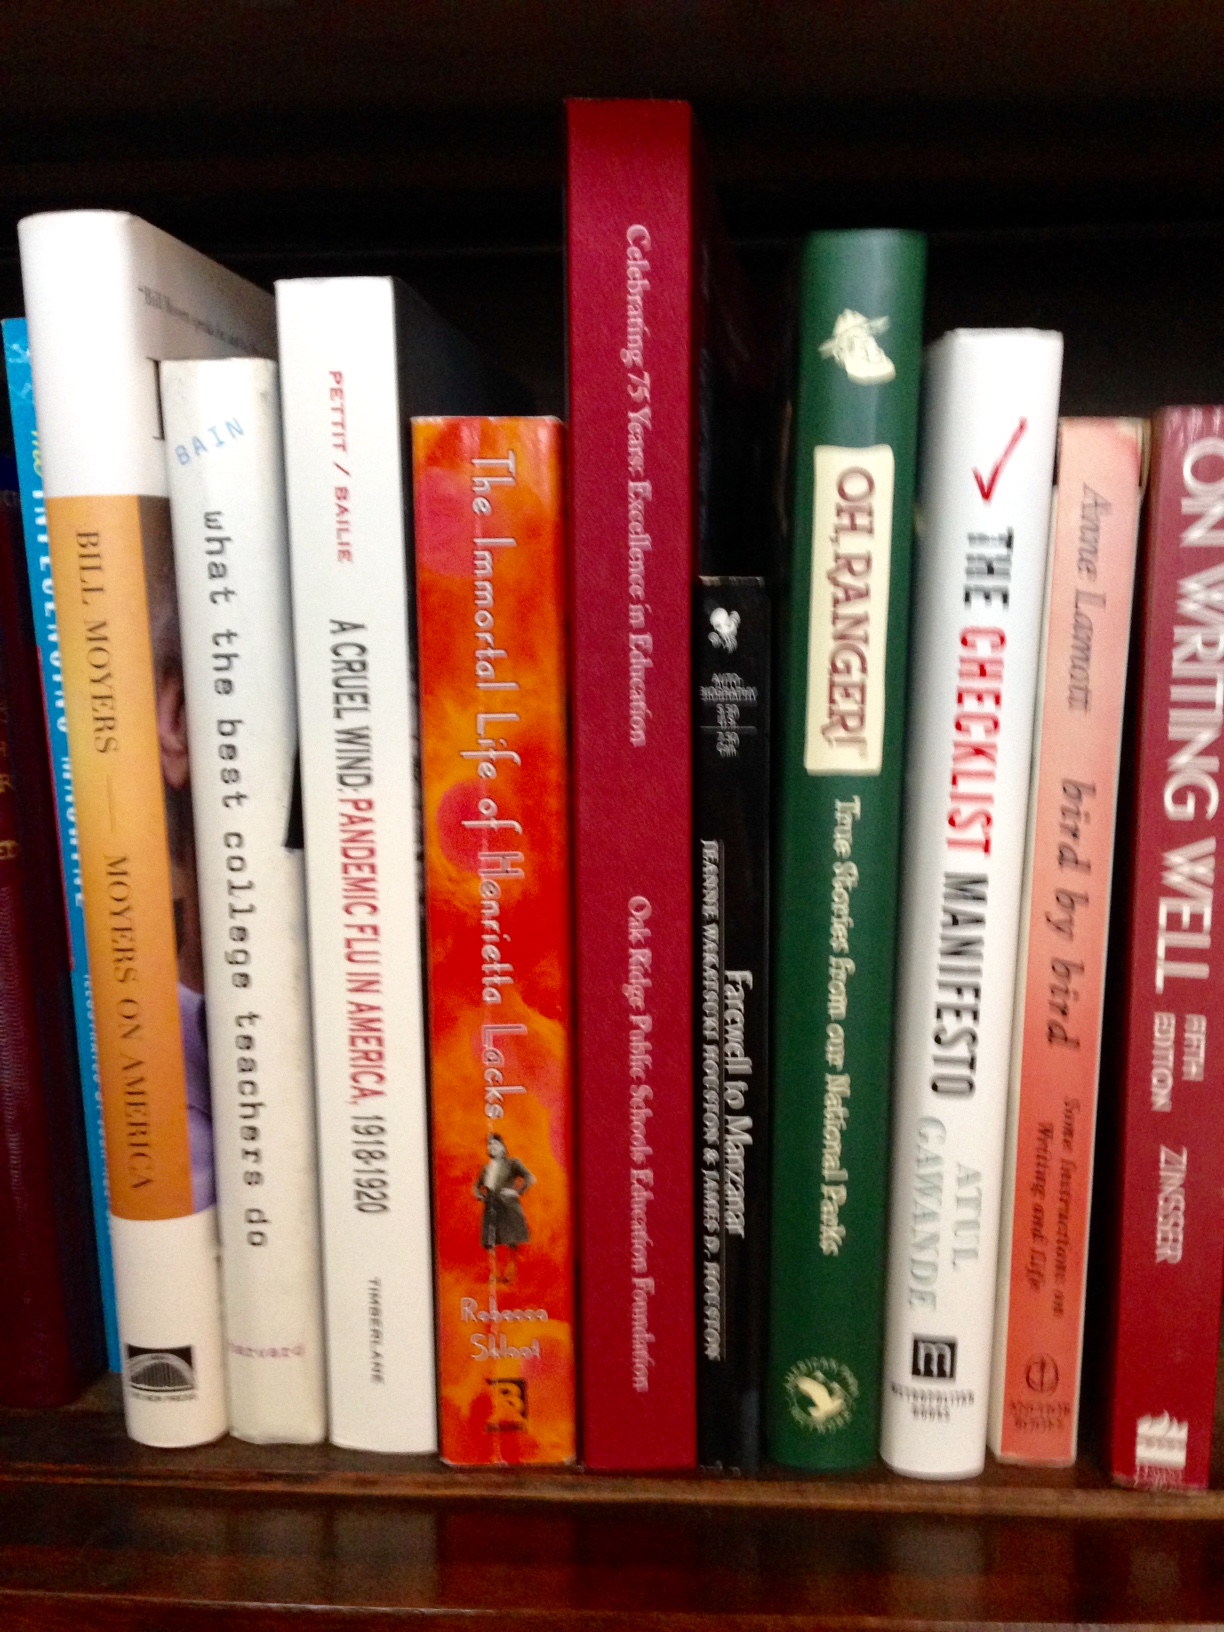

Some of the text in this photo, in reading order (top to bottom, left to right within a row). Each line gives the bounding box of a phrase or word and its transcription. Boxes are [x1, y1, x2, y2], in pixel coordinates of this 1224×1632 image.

[175, 418, 245, 465] BAIN
[329, 370, 349, 452] PETTIT
[334, 486, 353, 563] BAILIE
[620, 224, 654, 746] Celebrating 75 Years: Excellence in Education
[829, 467, 876, 544] OH,
[76, 531, 118, 755] BILL MOYERS
[1069, 484, 1111, 713] Anne Lamott
[1155, 438, 1224, 994] ON WRITING WELL
[461, 450, 527, 1118] The Immortal Life of Henrietta Lacks
[930, 528, 1014, 1100] THE CHECKLIST MANIFESTO
[104, 855, 138, 984] MOYERS
[203, 511, 270, 1248] what the best college teachers do
[329, 619, 390, 1213] A CRUEL WIND: PANDEMIC FLU IN AMERICA, 1918-1920
[701, 839, 719, 919] JEANNE
[1046, 778, 1096, 1050] bird by bird
[118, 998, 142, 1041] ON
[819, 795, 861, 1255] True Stories from our National Parks
[1151, 1012, 1176, 1112] EDITION
[122, 1053, 153, 1190] AMERICA
[622, 895, 654, 1393] Oak Ridge Public Schools Education Foundation
[702, 1044, 719, 1141] HOUSTON
[724, 971, 753, 1238] Farewell to Manzanar
[1059, 1096, 1080, 1151] Some
[702, 1147, 719, 1165] &
[702, 1168, 719, 1232] JAMES
[908, 1117, 946, 1311] GAWANDE
[952, 1162, 983, 1270] ATUL
[1026, 1122, 1055, 1292] Writing and Life
[1155, 1145, 1188, 1264] ZINSSER
[1053, 1159, 1076, 1286] Instructions
[366, 1278, 385, 1384] TIMBERLANE
[461, 1298, 547, 1322] Rebecca
[470, 1333, 540, 1360] Skloot
[703, 1261, 720, 1361] HOUSTON
